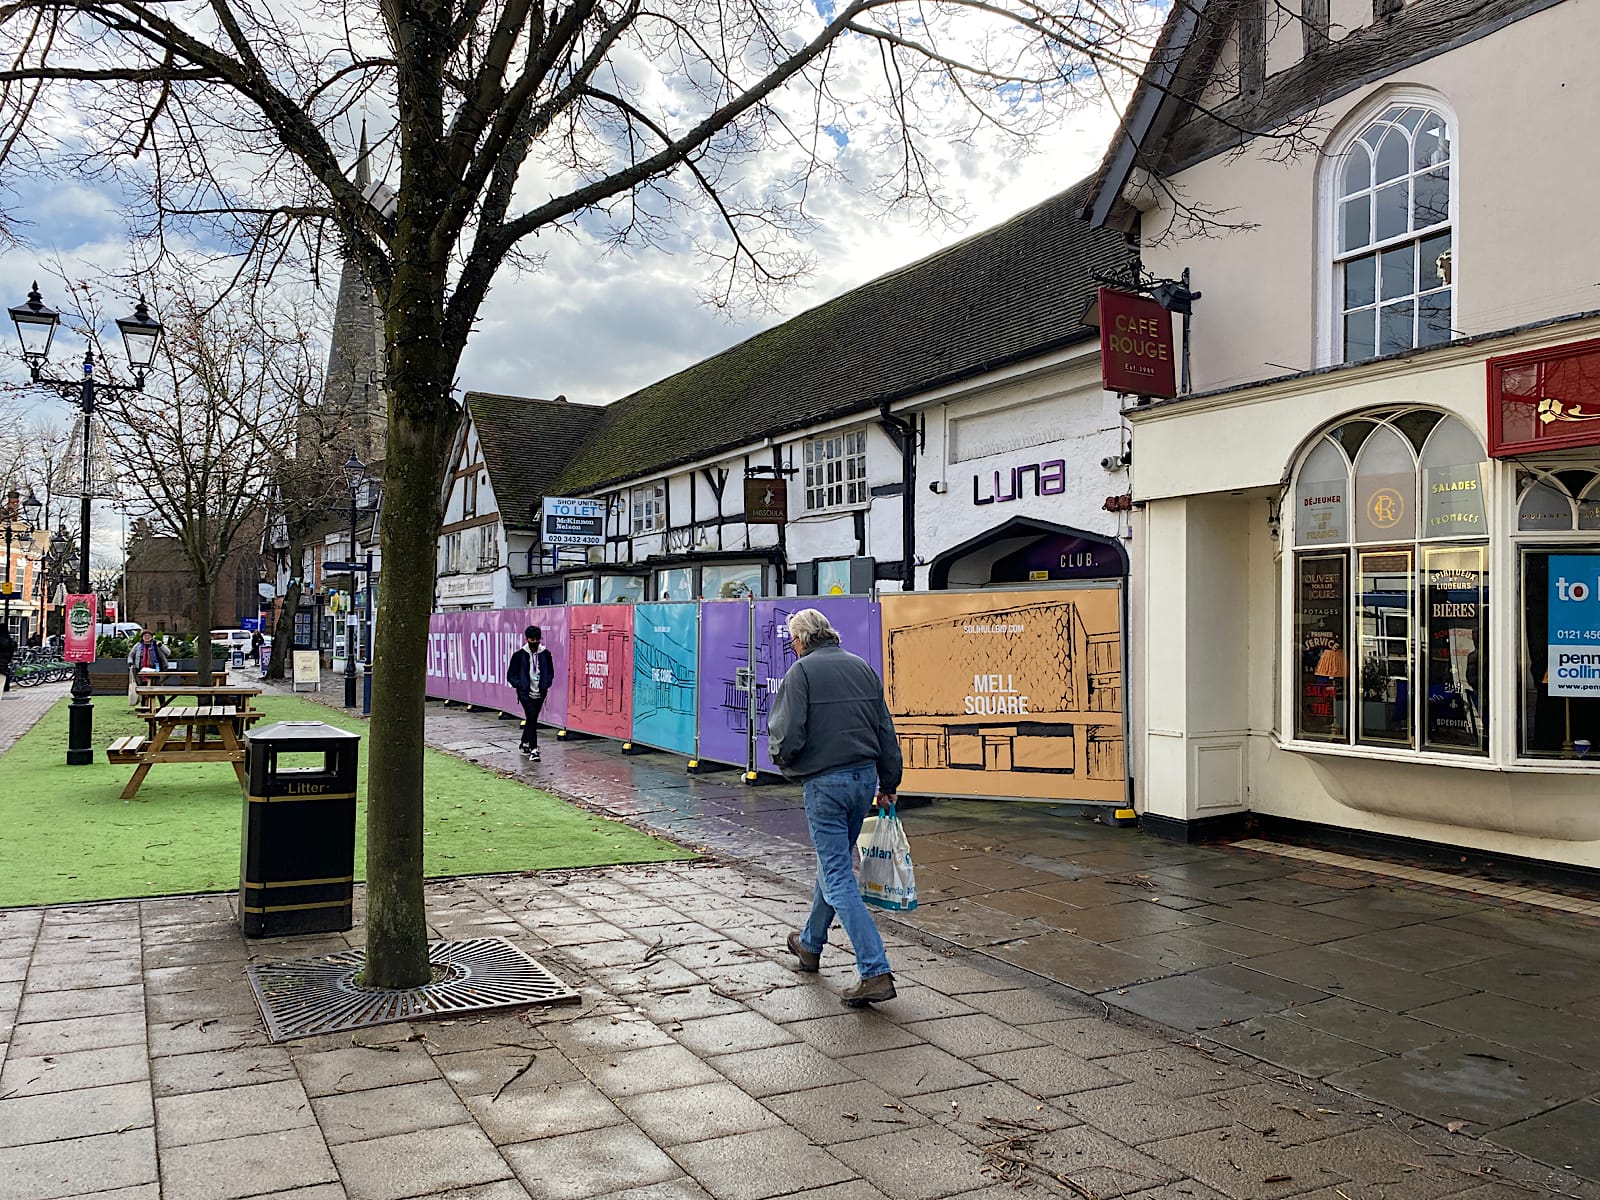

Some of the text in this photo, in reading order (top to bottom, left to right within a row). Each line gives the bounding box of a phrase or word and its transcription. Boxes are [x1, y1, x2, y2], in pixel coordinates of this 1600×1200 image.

[1109, 334, 1168, 361] ROUGE
[1431, 480, 1478, 494] SALADES
[1304, 495, 1342, 506] DÉJEUNER
[552, 505, 598, 516] TO LET
[556, 517, 594, 525] McKinnon
[1431, 512, 1480, 527] FROMAGES
[1431, 569, 1478, 583] SPIRITUEUX
[1436, 582, 1471, 590] LIQUEURS
[1556, 577, 1590, 601] to
[1432, 600, 1476, 618] BIÈRES
[1557, 630, 1580, 639] 0121
[1304, 637, 1341, 651] SERVICE
[974, 674, 1018, 693] MELL
[964, 695, 1030, 716] SQUARE
[288, 782, 326, 794] Litter
